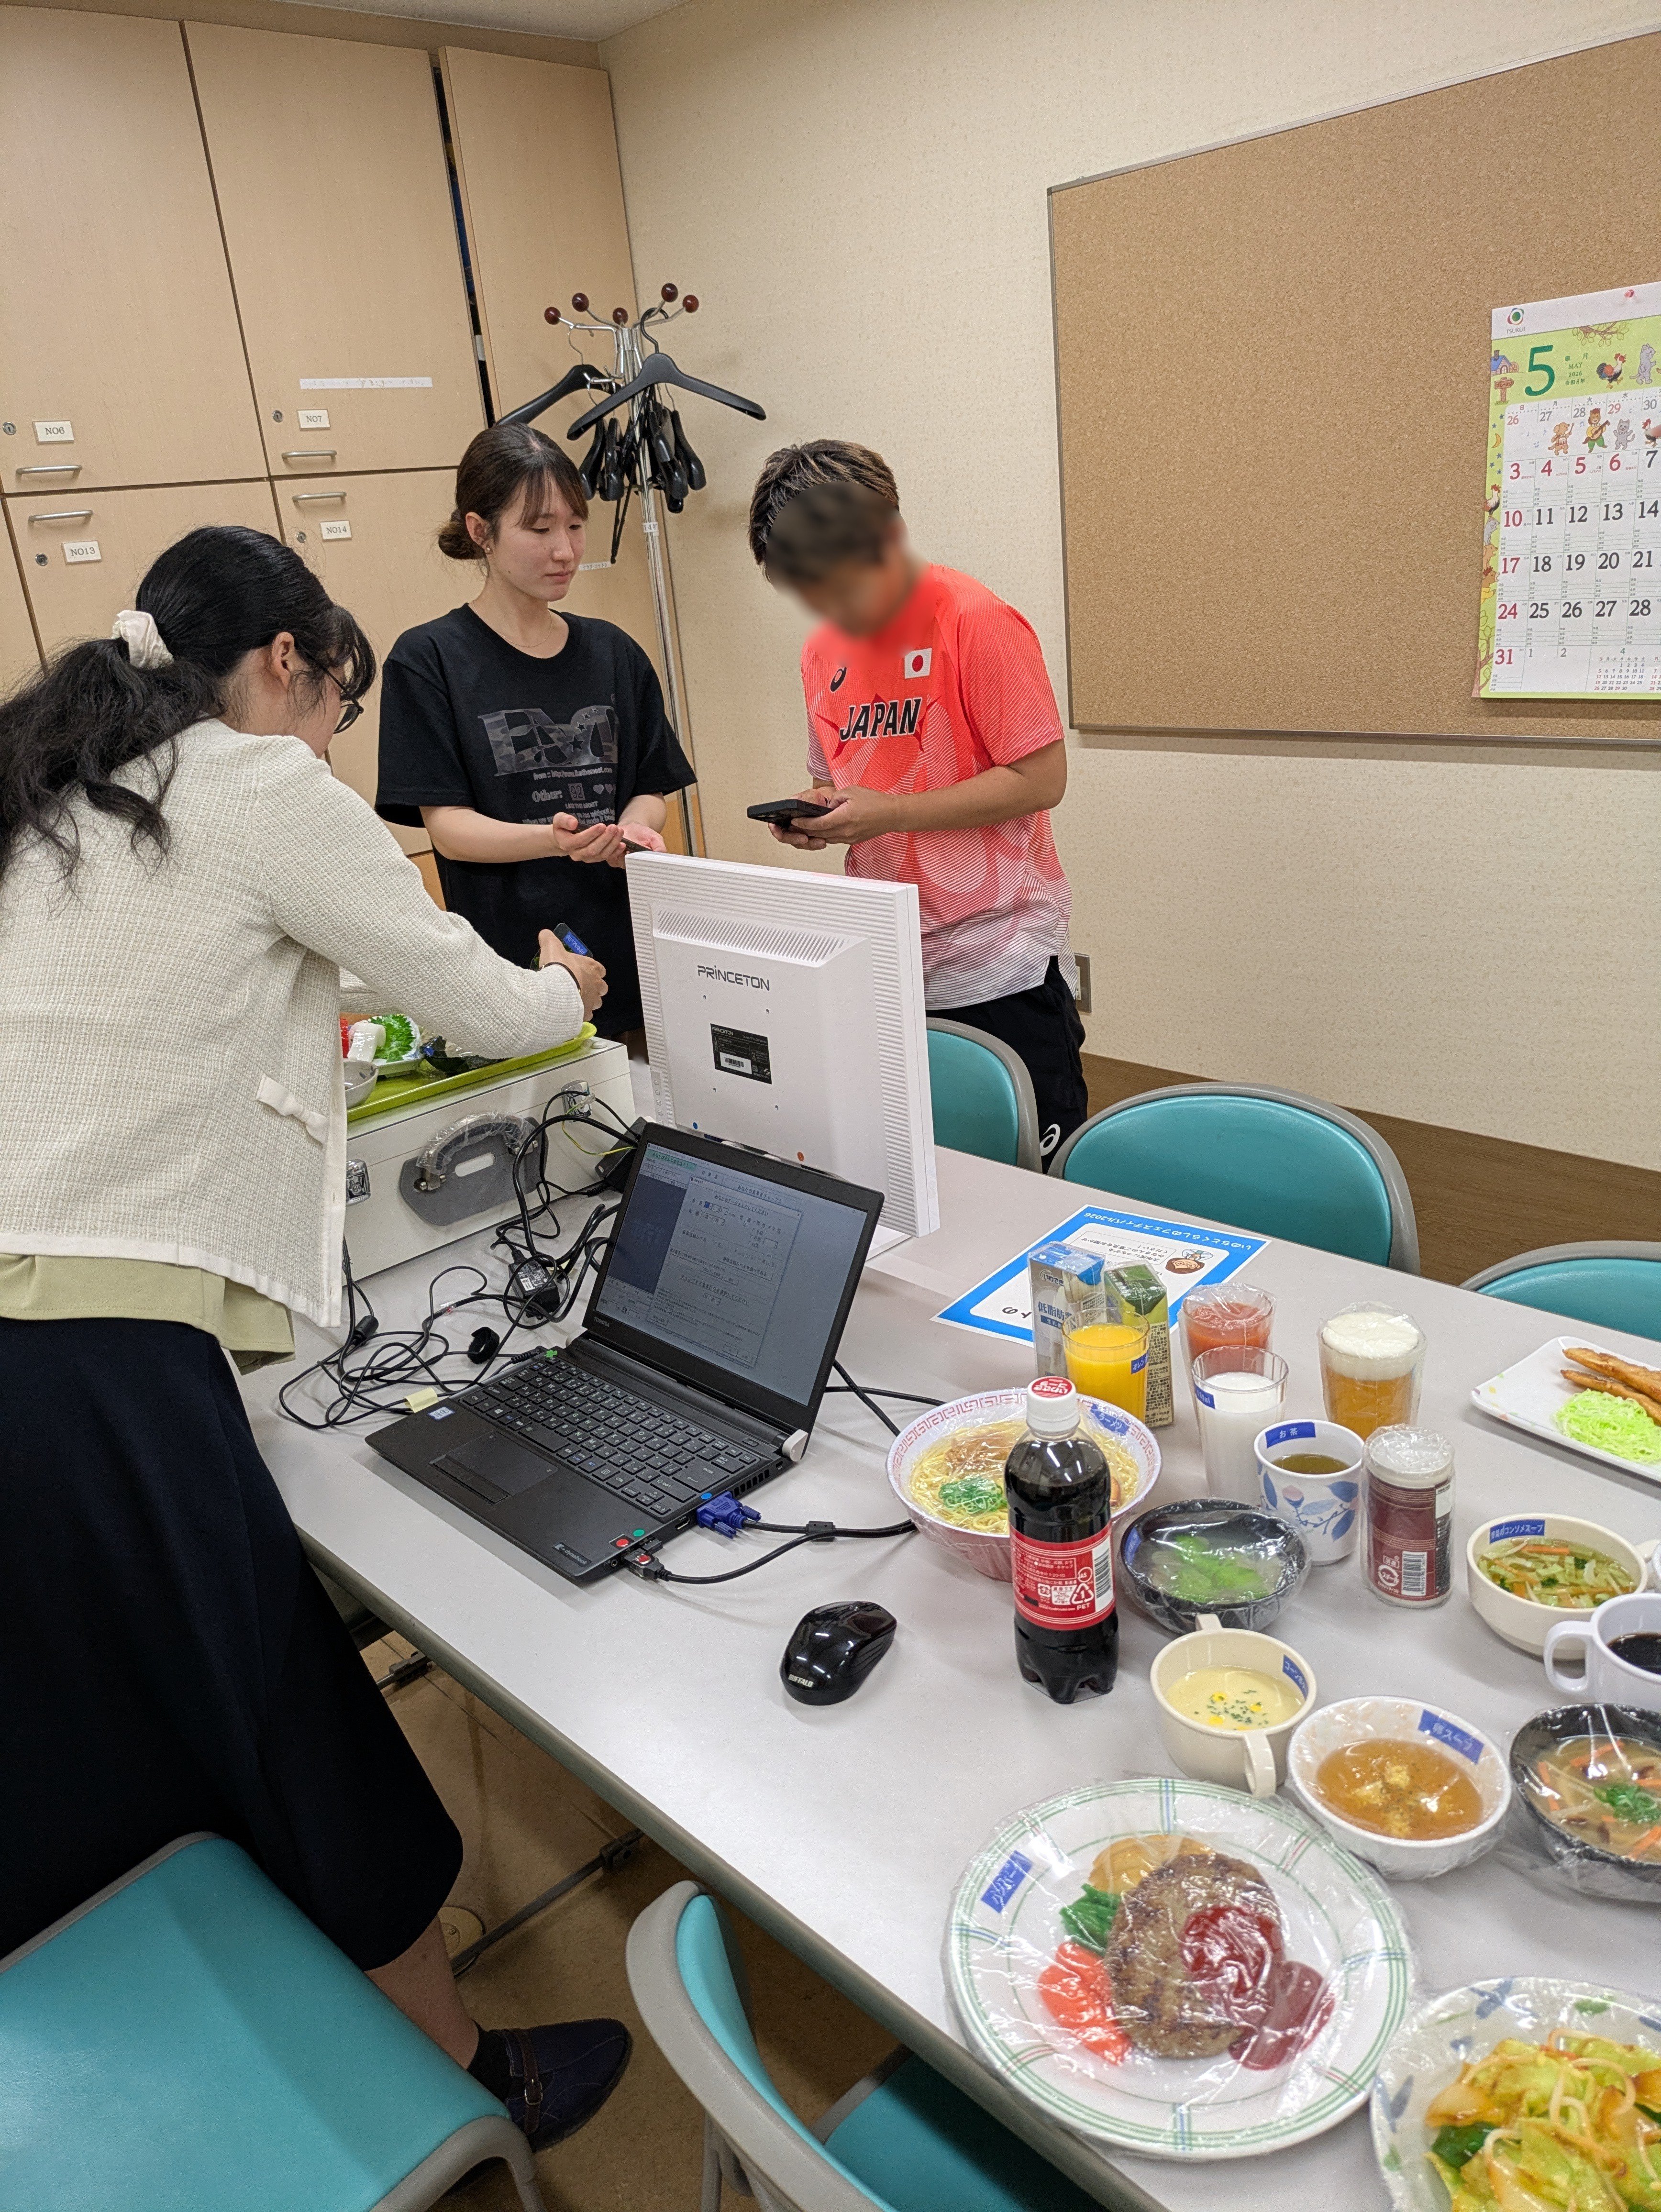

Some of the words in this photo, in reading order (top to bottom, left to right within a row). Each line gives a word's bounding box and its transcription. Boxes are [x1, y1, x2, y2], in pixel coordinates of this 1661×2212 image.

[1525, 345, 1555, 396] 5
[306, 414, 323, 424] NO7
[1507, 415, 1519, 425] 26
[1539, 411, 1552, 421] 27
[1573, 408, 1586, 418] 28
[1608, 403, 1621, 414] 29
[1643, 399, 1657, 410] 30
[44, 426, 65, 436] NO6
[1510, 463, 1520, 480] 3
[1540, 460, 1552, 476] 4
[1574, 456, 1586, 475] 5
[1609, 453, 1621, 471] 6
[1646, 450, 1658, 468] 7
[1504, 510, 1522, 527] 10
[1536, 508, 1554, 525] 11
[1569, 506, 1588, 523] 12
[1603, 503, 1623, 521] 13
[1638, 500, 1659, 519] 14
[326, 526, 347, 535] NO14
[70, 546, 96, 557] NO13
[1502, 557, 1520, 574] 17
[1533, 555, 1551, 572] 18
[1565, 553, 1585, 571] 19
[1597, 552, 1620, 569] 20
[1632, 550, 1653, 568] 21
[1498, 603, 1517, 619] 24
[1529, 602, 1549, 619] 25
[1561, 601, 1582, 618] 26
[1595, 600, 1617, 617] 27
[1629, 599, 1651, 617] 28
[1495, 649, 1513, 665] 31
[1528, 648, 1533, 658] 1
[1560, 648, 1567, 657] 2
[840, 697, 922, 742] JAPAN
[532, 789, 563, 802] Other:
[697, 965, 770, 991] PRINCETON
[1084, 1211, 1252, 1250] いのちとくらしのフェスティバル2026
[1099, 1412, 1122, 1429] ラーメン
[1279, 1427, 1298, 1438] お茶
[1081, 1590, 1085, 1599] 1
